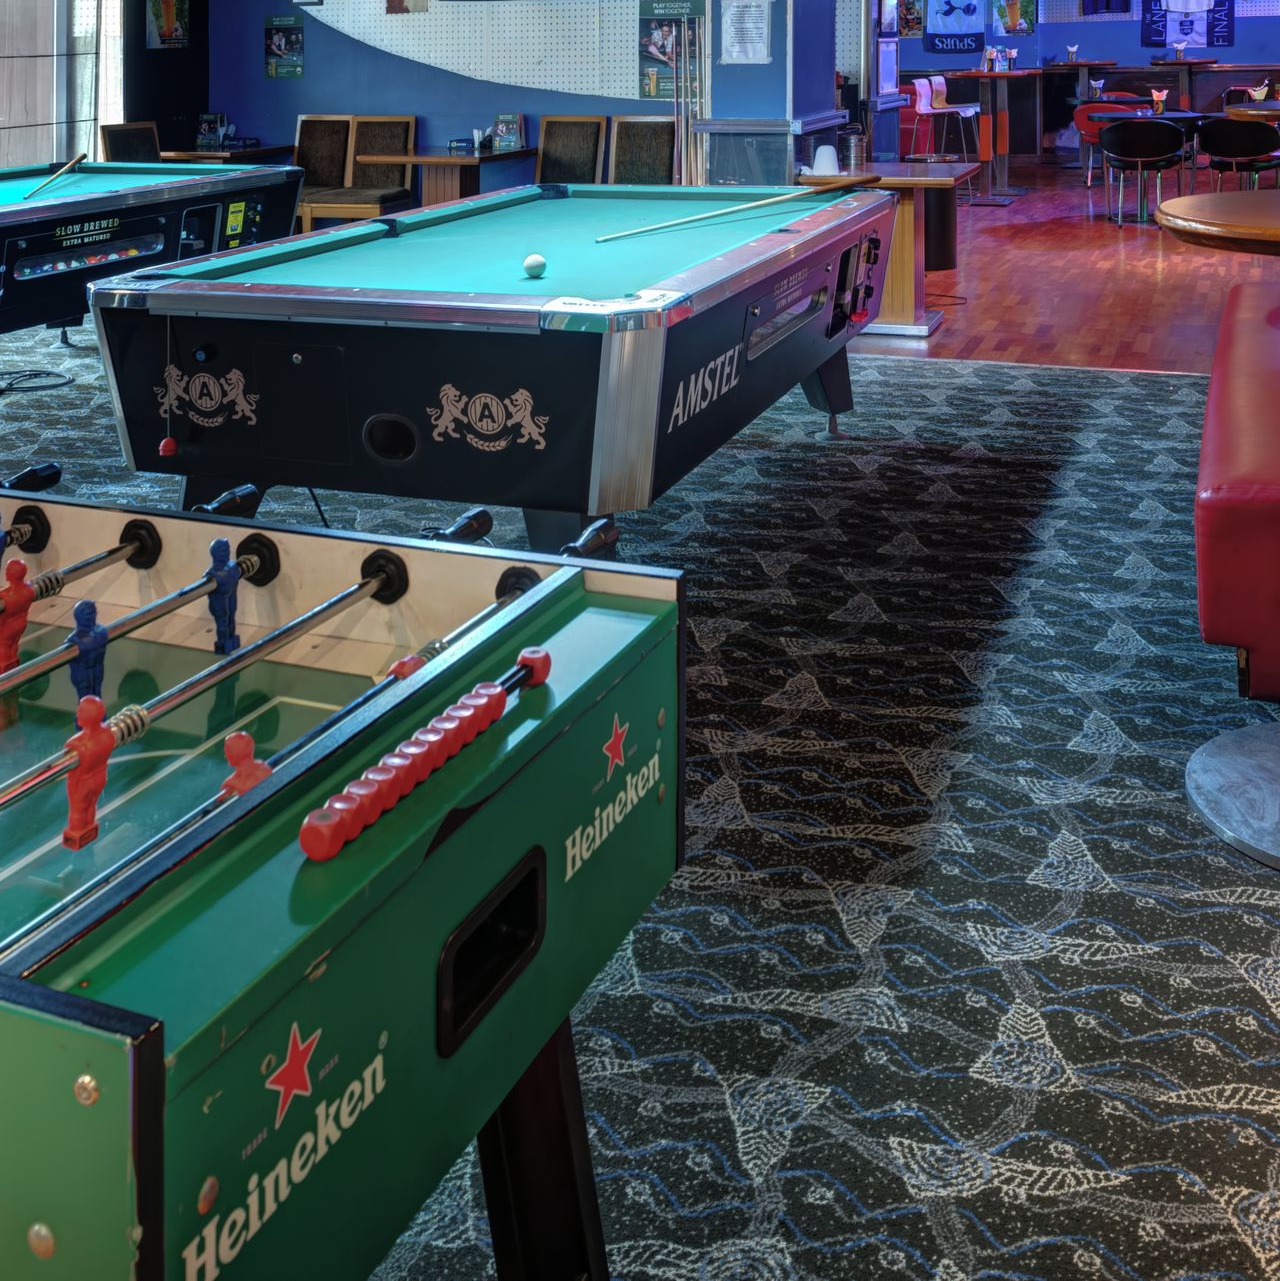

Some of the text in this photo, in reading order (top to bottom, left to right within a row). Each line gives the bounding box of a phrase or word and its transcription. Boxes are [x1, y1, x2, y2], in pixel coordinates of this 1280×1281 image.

[1151, 1, 1166, 40] LANE
[935, 37, 976, 49] SPURS
[55, 218, 120, 237] SLOW BREWED
[62, 237, 82, 247] EXTRA
[197, 381, 212, 402] A
[667, 345, 740, 434] AMSTEL
[477, 402, 498, 424] A
[564, 752, 661, 884] Heineken
[181, 1053, 387, 1281] Heineken
